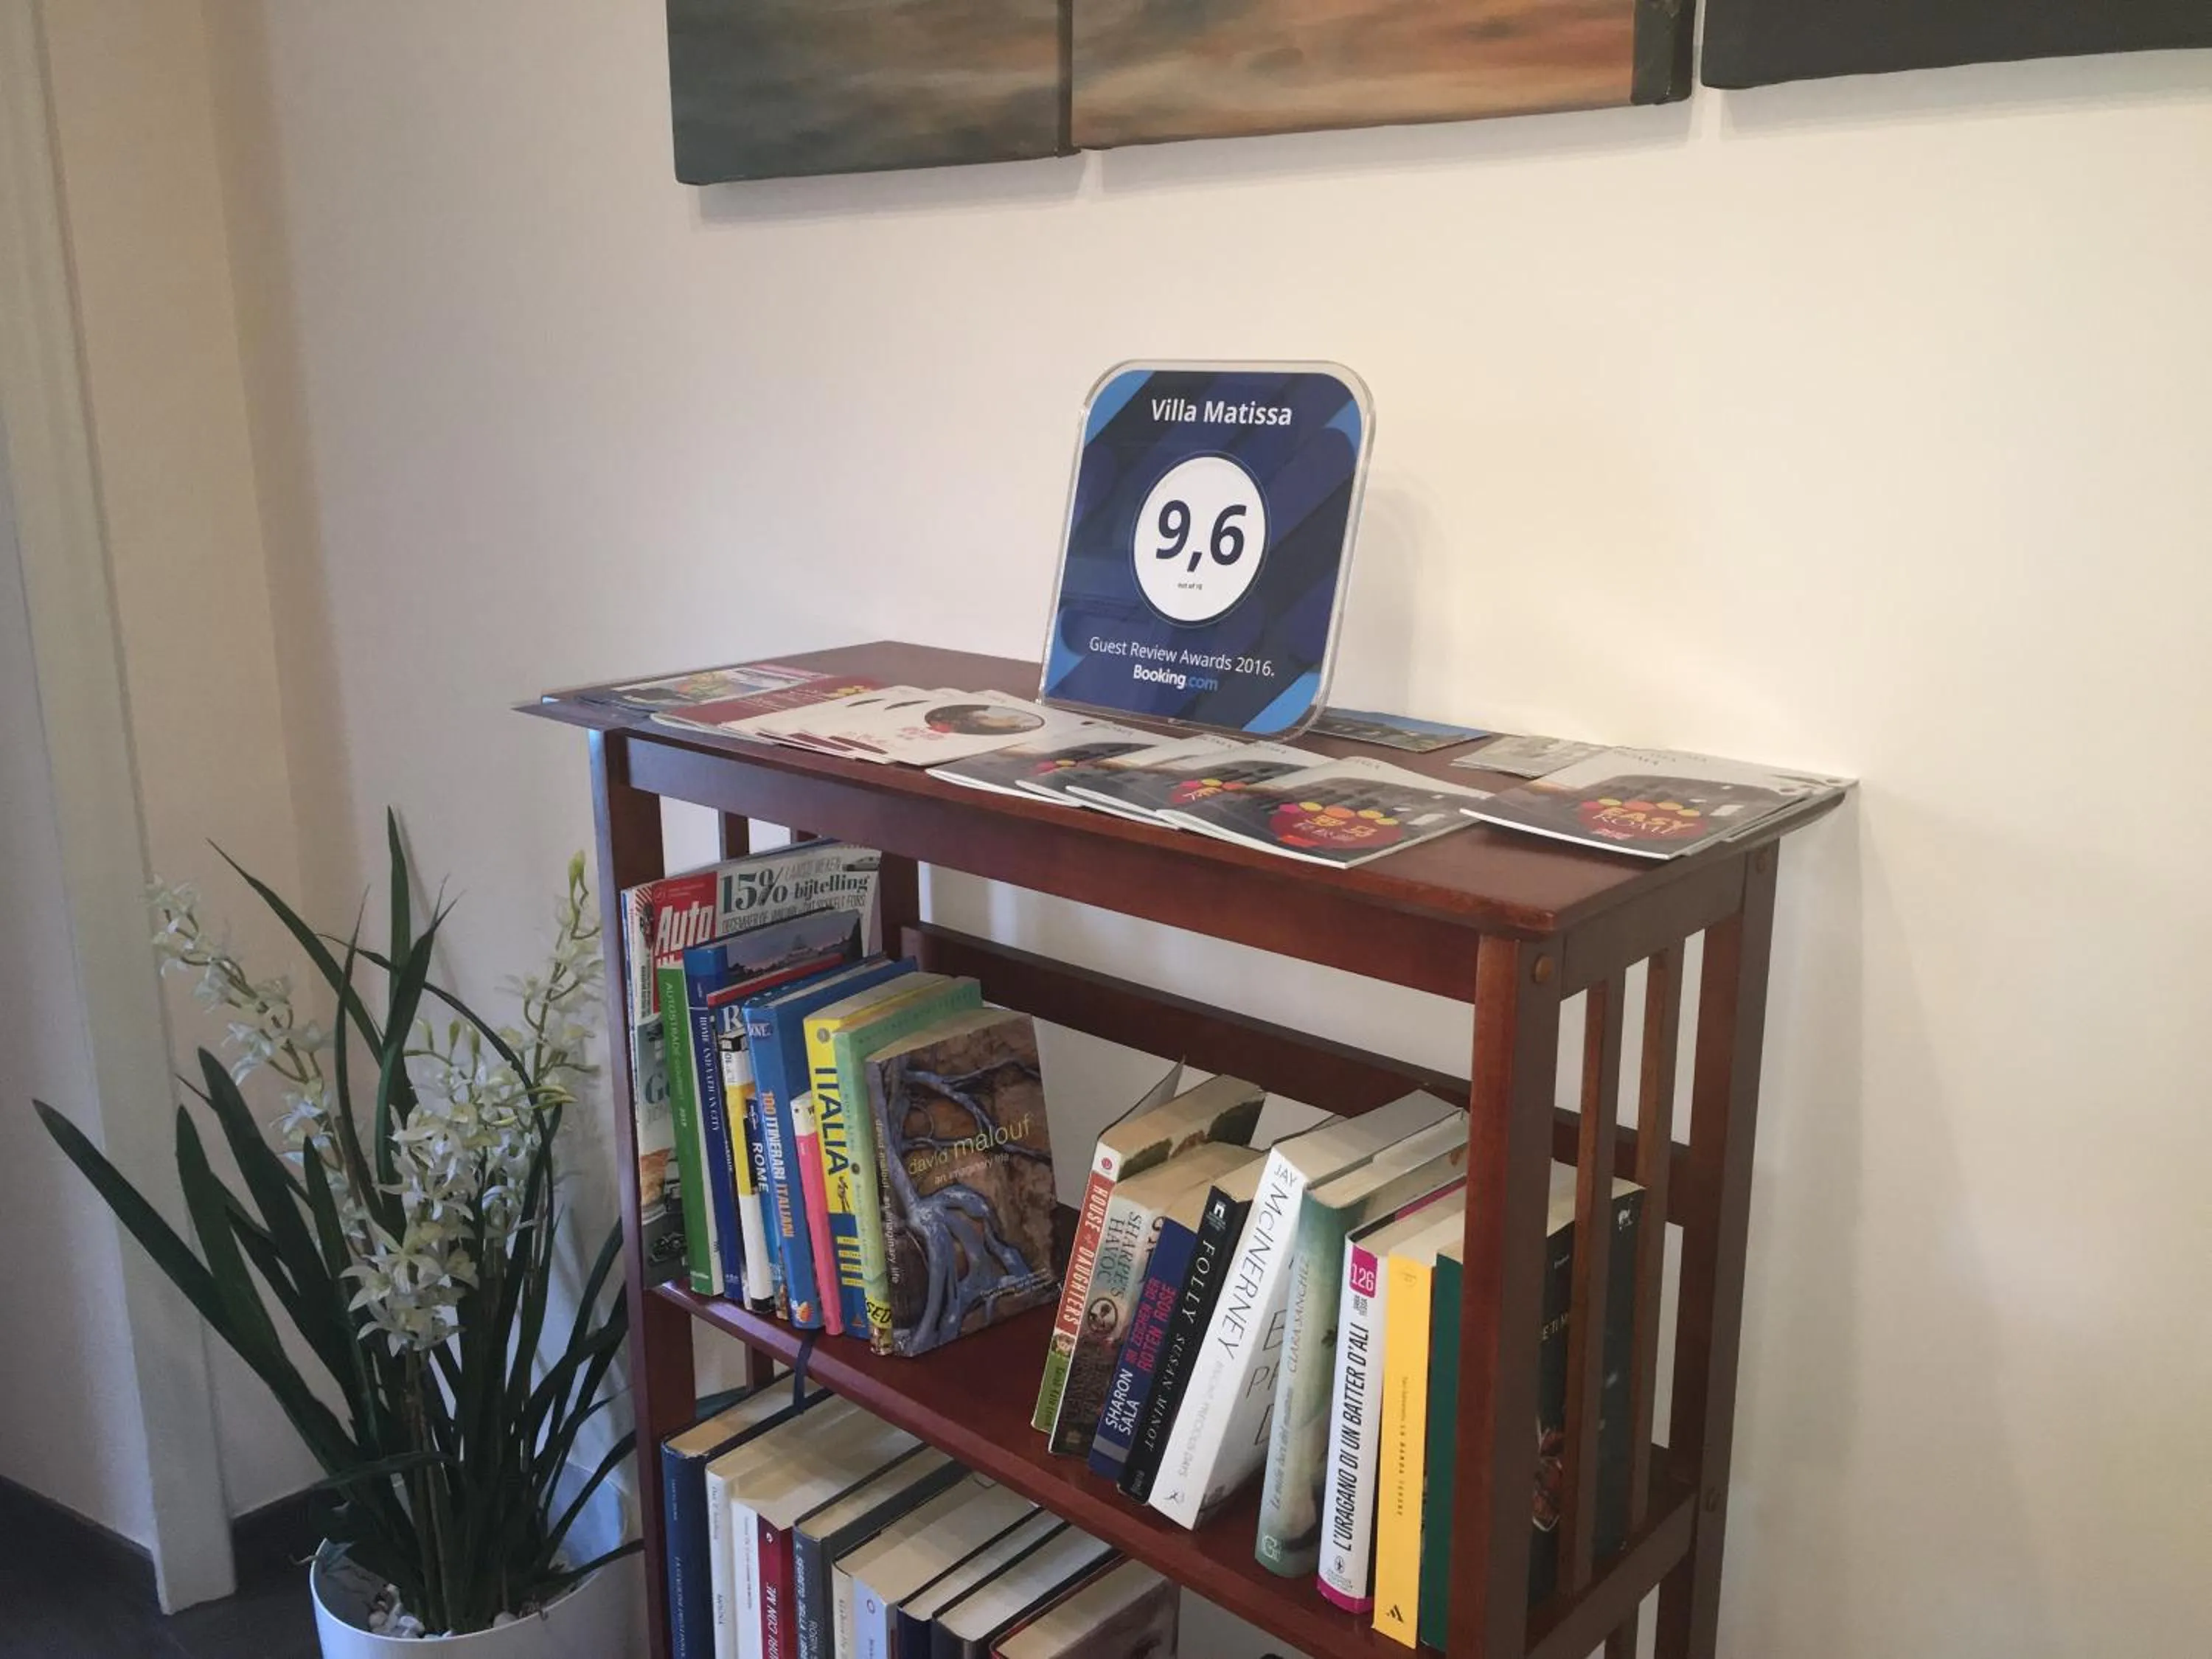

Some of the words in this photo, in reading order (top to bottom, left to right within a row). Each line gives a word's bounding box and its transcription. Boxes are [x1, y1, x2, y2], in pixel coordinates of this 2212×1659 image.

[1152, 399, 1197, 422] Villa
[1203, 401, 1293, 425] Matissa
[1155, 499, 1248, 572] 9,6
[1089, 637, 1127, 656] Guest
[1130, 642, 1177, 662] Review
[1180, 650, 1231, 671] Awards
[1236, 658, 1276, 677] 2016.
[1133, 664, 1218, 691] Booking.com
[722, 868, 788, 914] 15%
[793, 874, 869, 900] bijtelling
[655, 901, 714, 956] Auto
[762, 1091, 776, 1115] 100
[815, 1068, 849, 1175] ITALIA
[751, 1142, 768, 1192] ROME
[765, 1116, 785, 1180] ITINERARI
[908, 1150, 947, 1175] david
[953, 1113, 1030, 1159] malouf
[1274, 1164, 1296, 1188] JAY
[776, 1183, 794, 1238] ITALIANI
[1085, 1185, 1109, 1232] HOUSE
[1096, 1217, 1124, 1279] HAVOC
[1110, 1211, 1142, 1298] SHARPE'S
[891, 1266, 900, 1284] life
[1063, 1246, 1095, 1326] DAUGHTERS
[1182, 1239, 1215, 1324] FOLLY
[1351, 1261, 1374, 1292] 126
[865, 1298, 892, 1325] SED
[1137, 1326, 1163, 1372] ROTEN
[1154, 1285, 1176, 1322] ROSE
[1163, 1333, 1185, 1390] SUSAN
[1289, 1331, 1301, 1374] CLARA
[1347, 1321, 1370, 1371] D'ALI
[1105, 1368, 1133, 1429] SHARON
[1119, 1399, 1140, 1436] SALA
[1342, 1365, 1366, 1428] BATTER
[1145, 1395, 1166, 1451] MINOT
[1346, 1426, 1361, 1451] UN
[1346, 1448, 1358, 1469] DI
[1332, 1468, 1358, 1551] L'URAGANO
[765, 1582, 776, 1605] ME
[767, 1605, 778, 1635] CON
